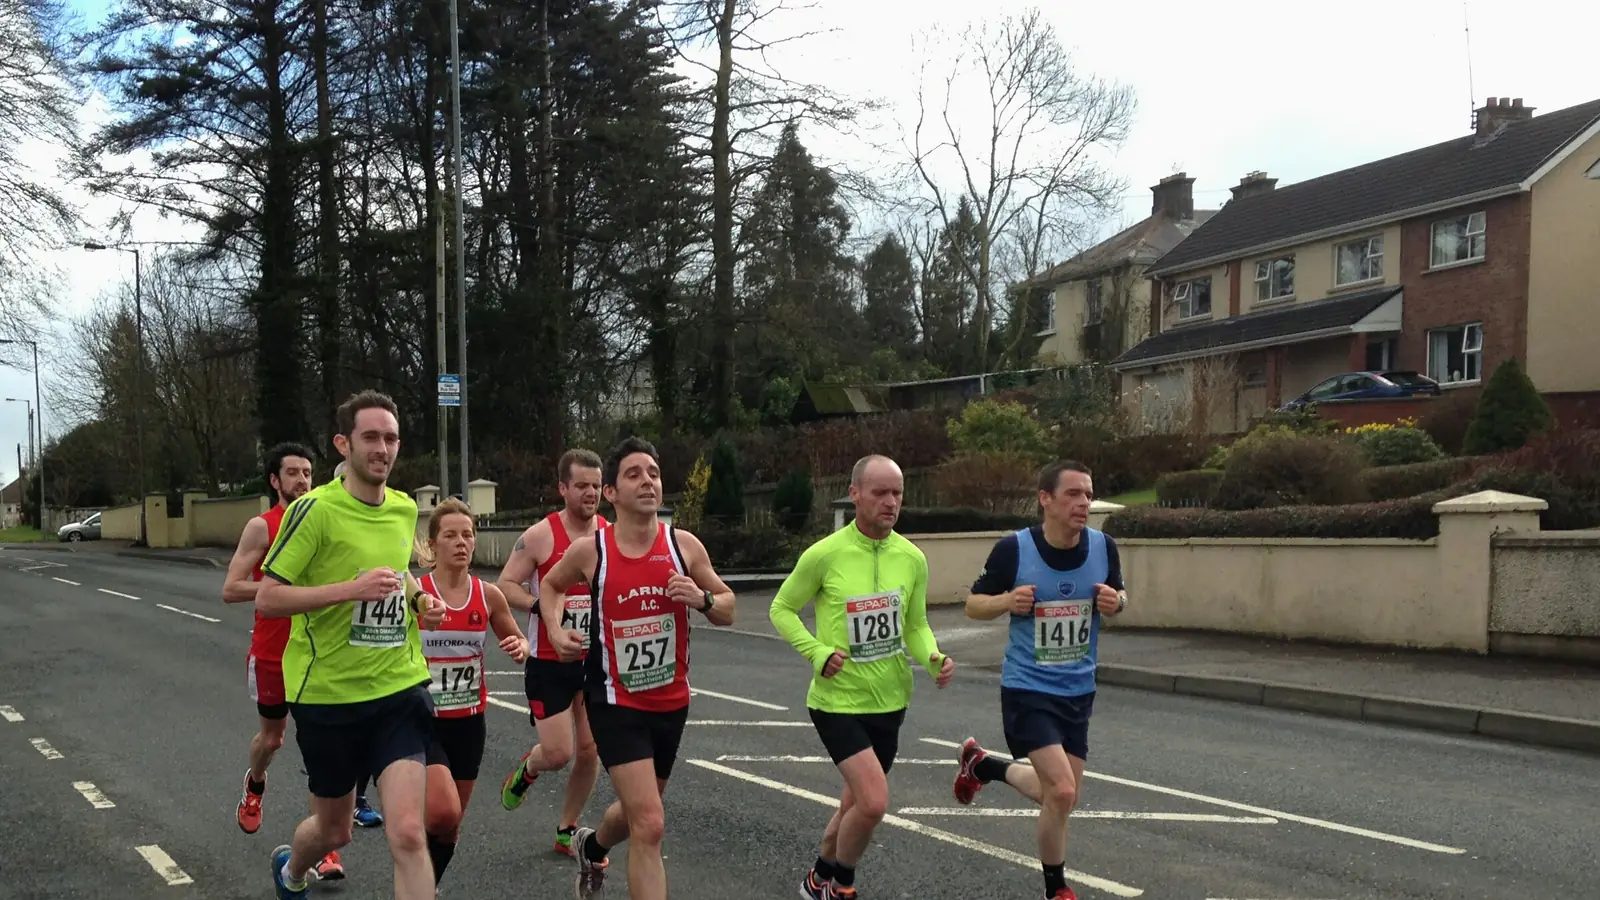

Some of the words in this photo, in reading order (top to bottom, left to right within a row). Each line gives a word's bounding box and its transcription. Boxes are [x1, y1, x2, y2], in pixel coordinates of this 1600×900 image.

[359, 595, 405, 626] 1445
[641, 599, 660, 611] A.C.
[856, 598, 888, 611] SPAR
[1044, 606, 1079, 617] SPAR
[623, 623, 661, 637] SPAR
[853, 611, 898, 643] 1281
[1041, 619, 1089, 646] 1416
[426, 639, 463, 648] LIFFORD
[624, 637, 669, 671] 257
[442, 666, 475, 691] 179
